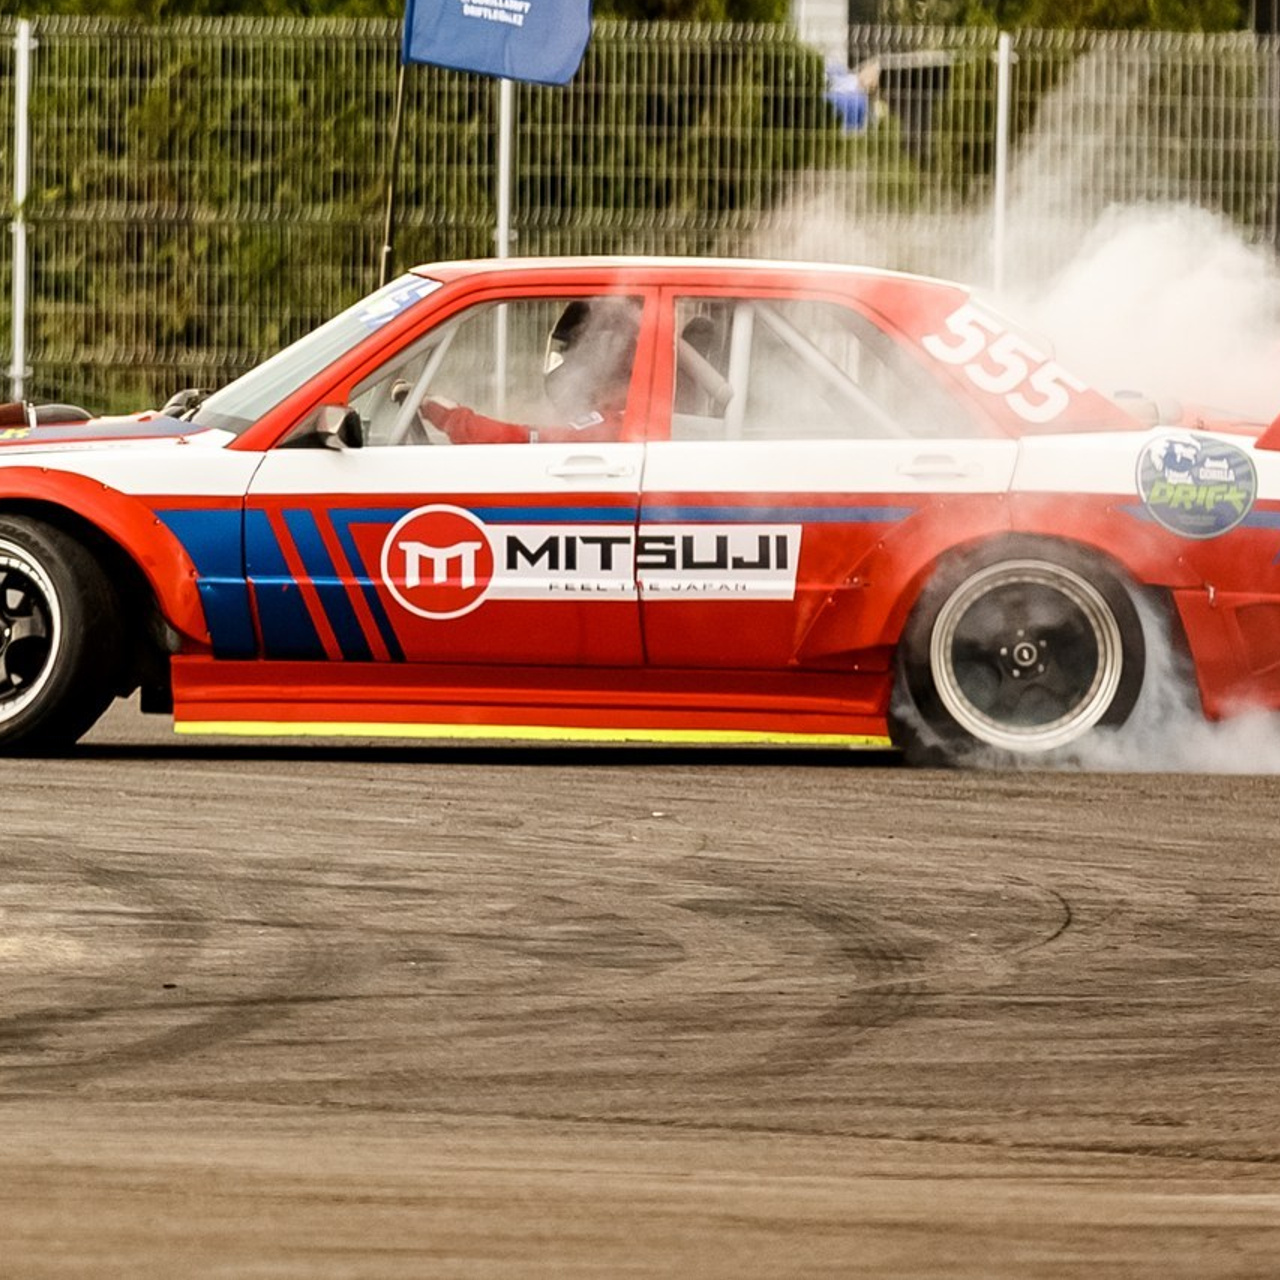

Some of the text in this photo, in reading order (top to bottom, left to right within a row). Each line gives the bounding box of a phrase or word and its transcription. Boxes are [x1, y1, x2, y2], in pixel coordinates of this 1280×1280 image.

[921, 302, 1089, 423] 555
[1148, 481, 1247, 515] DRIFT
[506, 535, 789, 571] MITSUJI
